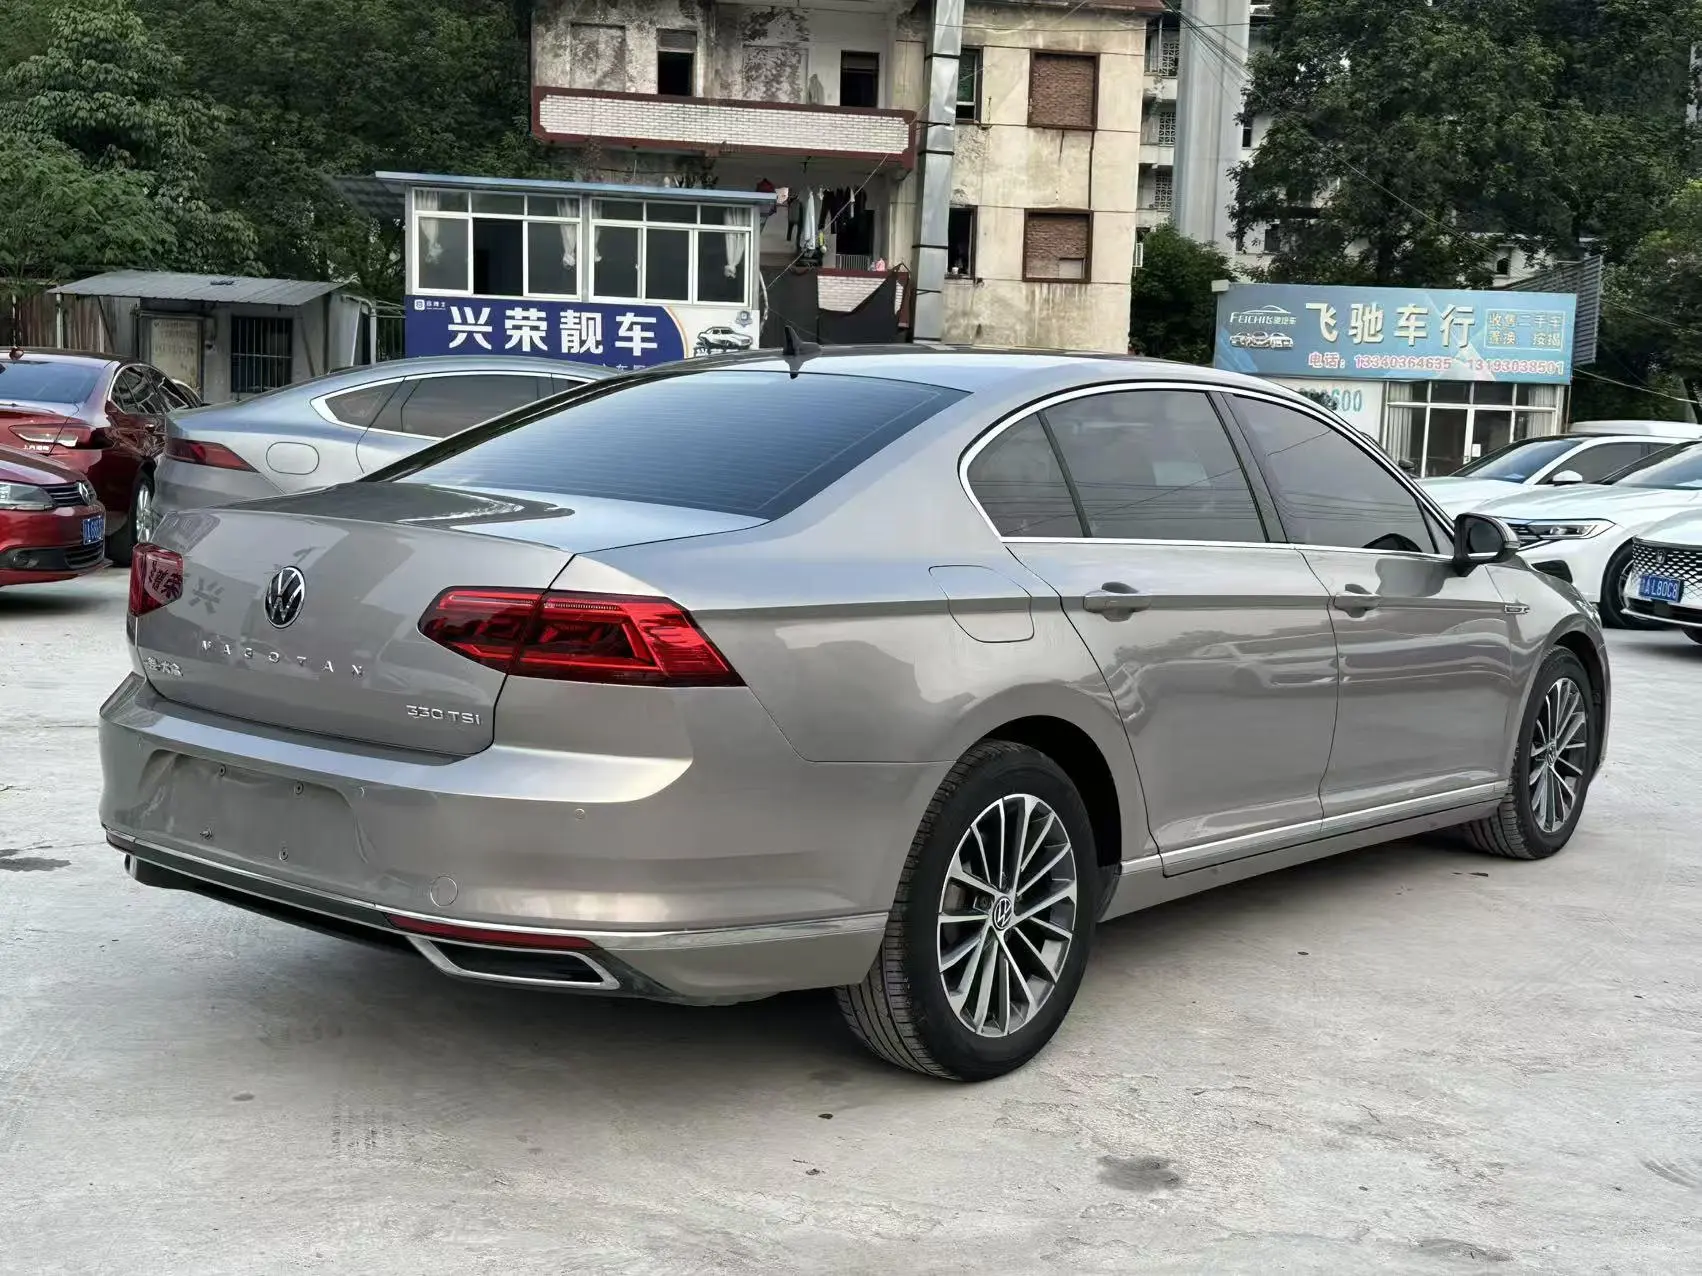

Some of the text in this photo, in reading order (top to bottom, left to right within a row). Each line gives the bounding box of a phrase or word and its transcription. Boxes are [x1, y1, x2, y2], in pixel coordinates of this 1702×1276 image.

[447, 306, 658, 356] 兴荣靓车
[1305, 302, 1475, 348] 飞驰车行
[202, 640, 364, 680] MAGOTAN
[406, 704, 481, 725] 330 TSI
